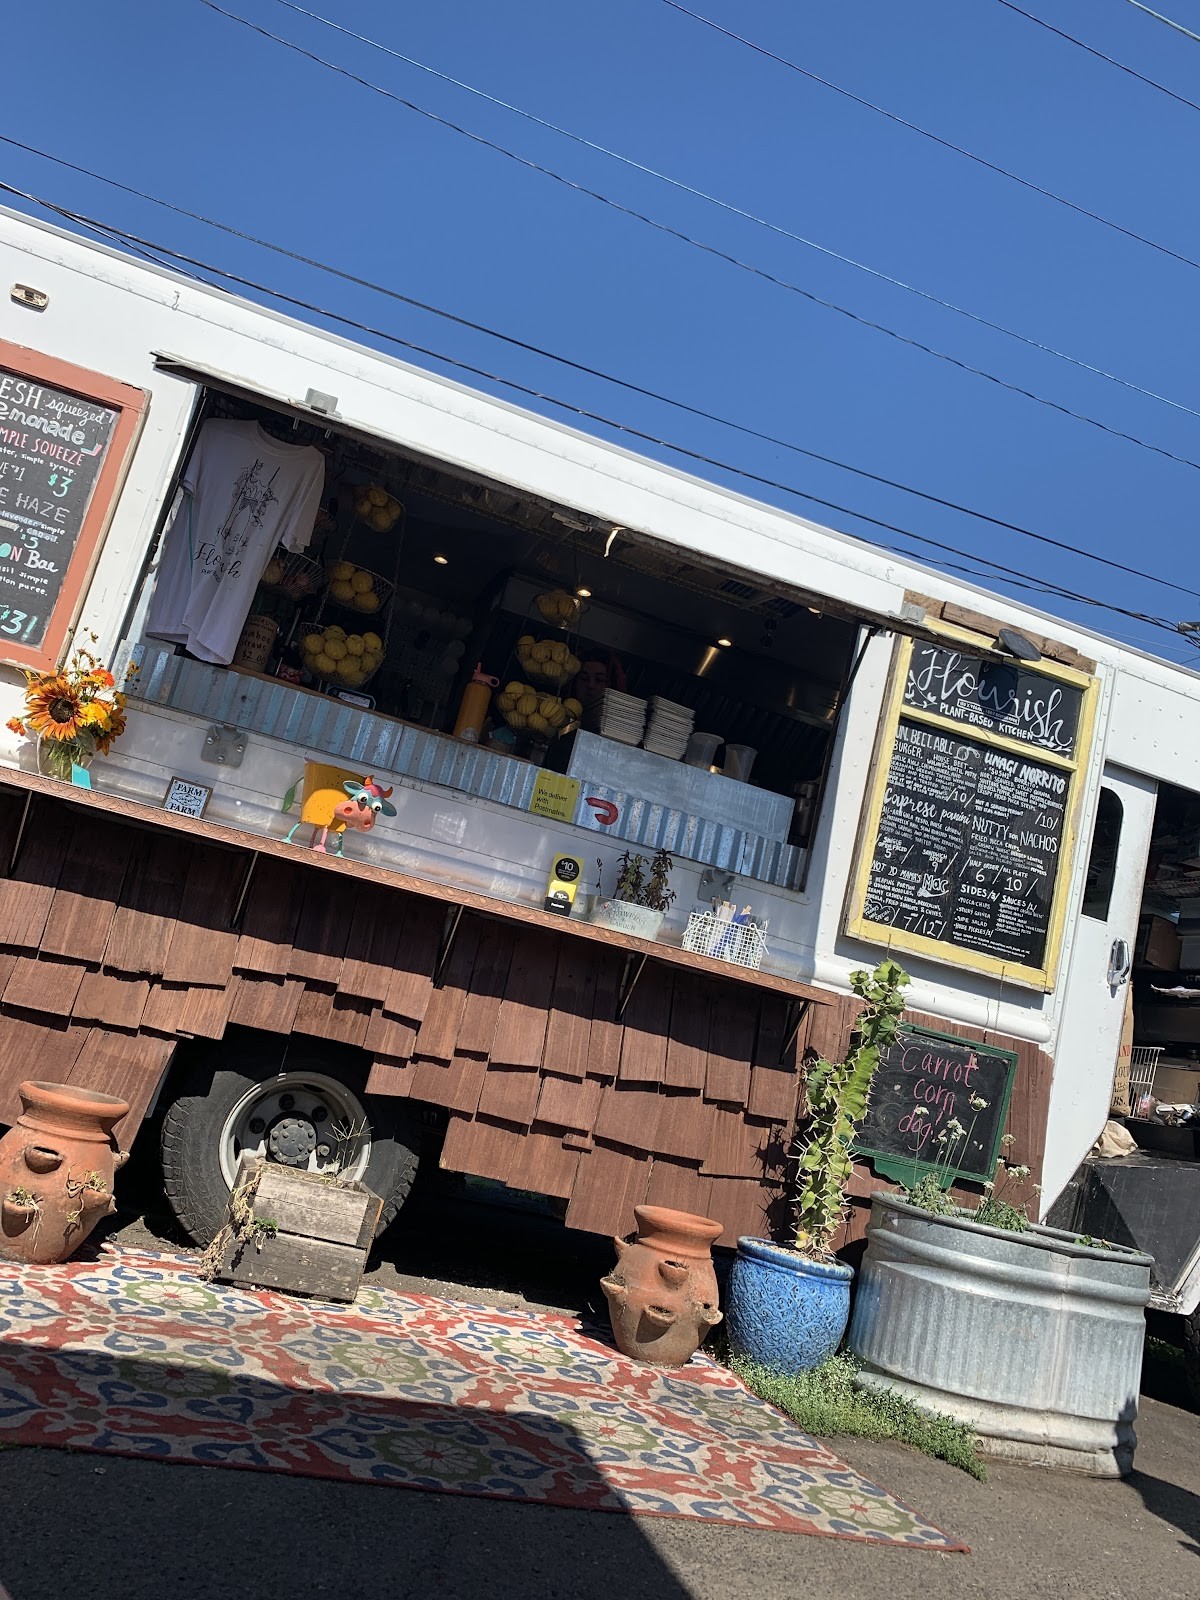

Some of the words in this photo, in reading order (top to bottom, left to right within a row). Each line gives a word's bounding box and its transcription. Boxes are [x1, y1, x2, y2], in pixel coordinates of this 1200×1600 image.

[45, 398, 105, 427] squeezed
[21, 453, 44, 464] simple
[49, 461, 77, 476] syrup.
[31, 438, 86, 467] SQUEEZE
[47, 473, 74, 498] $3
[15, 492, 71, 524] HAZE
[41, 523, 66, 535] simple
[23, 549, 59, 573] Bae
[18, 582, 48, 597] puree.
[19, 571, 49, 585] simple
[917, 648, 1073, 747] Flourish
[939, 702, 994, 728] PLANT-BASED
[998, 722, 1034, 741] KITCHEN
[984, 752, 1019, 774] UNAGI
[1020, 764, 1066, 795] NORRITO
[177, 783, 203, 797] FARM
[170, 803, 196, 816] FARM
[884, 787, 938, 818] Caprese
[971, 815, 1010, 841] NUTTY
[1009, 832, 1019, 841] FOR
[1019, 831, 1058, 854] NACHOS
[971, 833, 988, 843] FRIED
[884, 848, 892, 859] 5
[931, 861, 939, 873] 9
[922, 873, 949, 893] Mac
[975, 868, 985, 882] 6
[1003, 876, 1023, 892] 10
[960, 884, 988, 898] SIDES
[1001, 894, 1027, 907] SAUCES
[903, 915, 912, 931] 7
[922, 918, 937, 937] 12
[901, 1046, 980, 1088] Carrot
